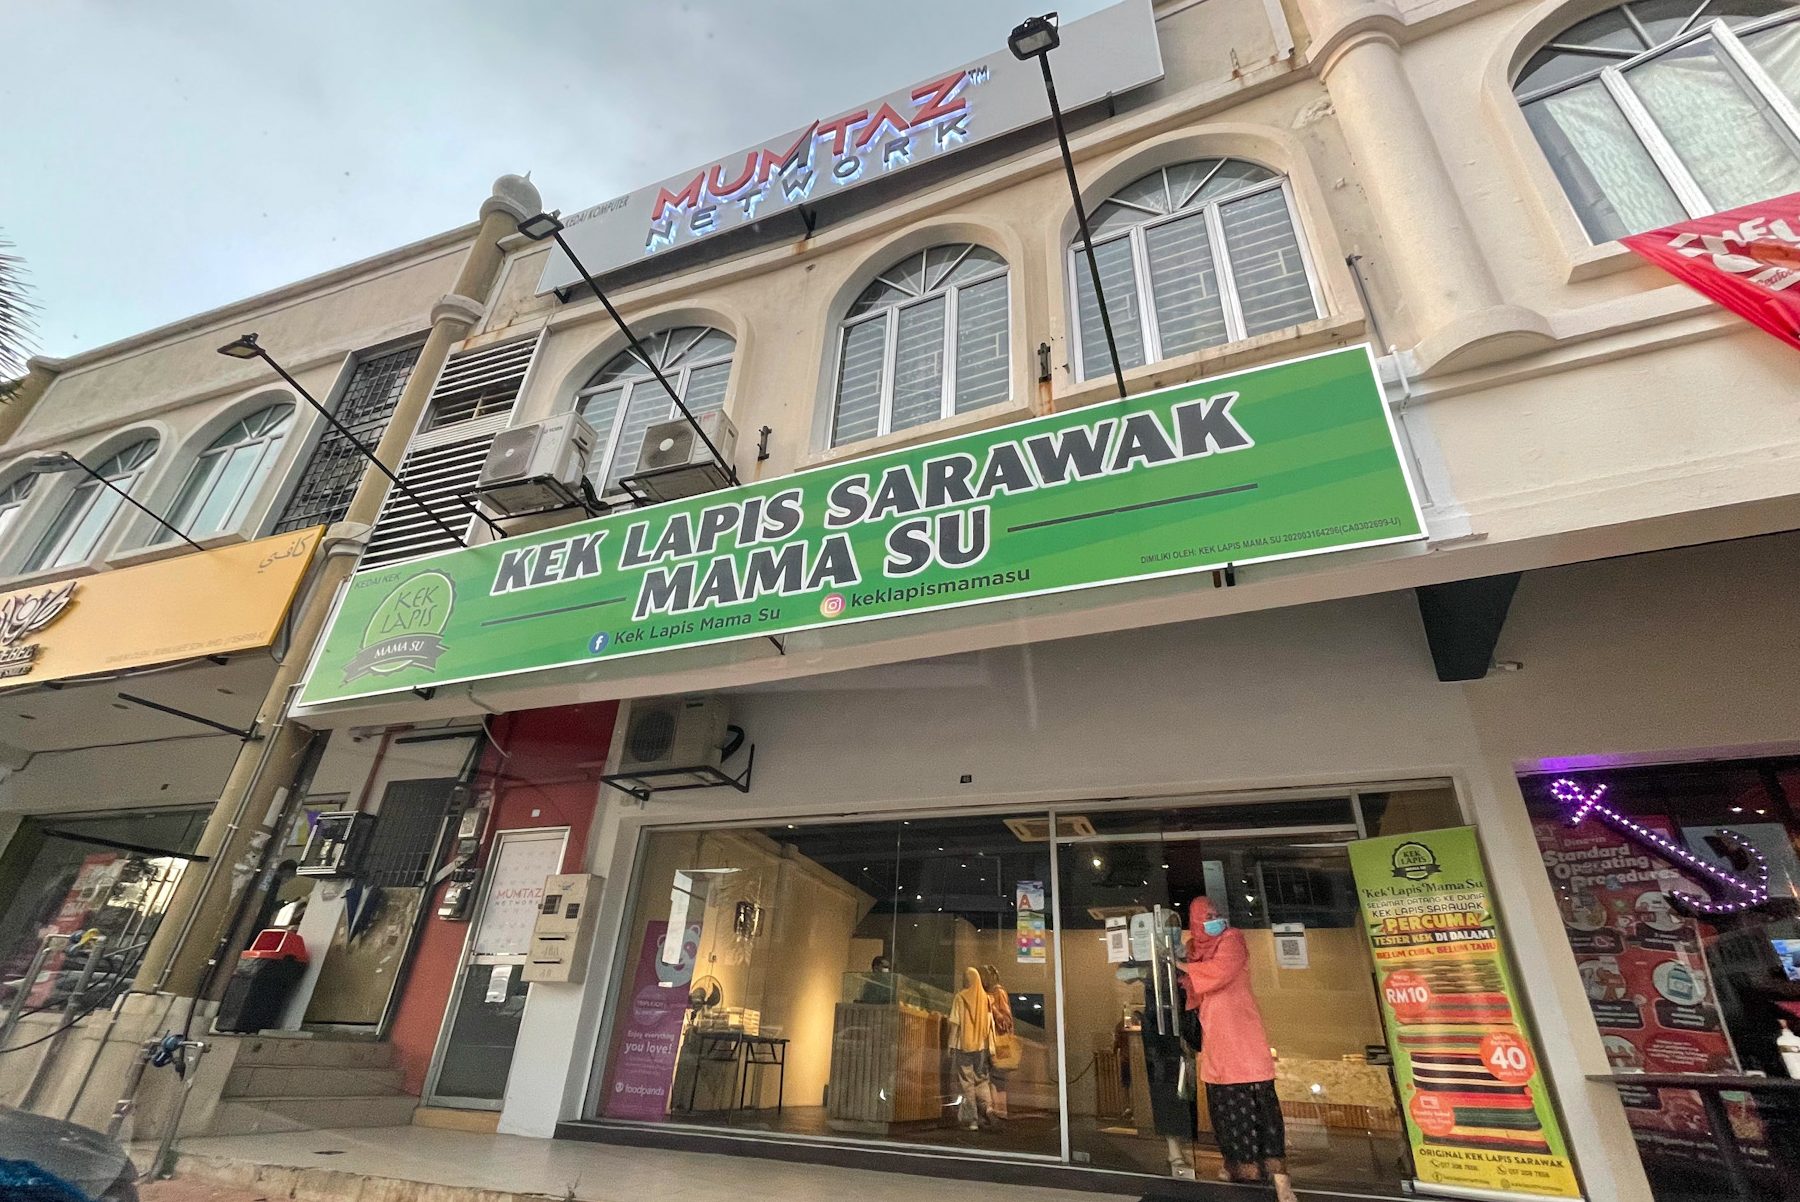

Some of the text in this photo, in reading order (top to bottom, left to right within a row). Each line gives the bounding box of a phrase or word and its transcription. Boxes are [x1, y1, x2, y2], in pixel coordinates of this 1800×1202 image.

[651, 70, 967, 221] MUMTAZ
[645, 113, 968, 250] NETWORK
[588, 195, 630, 220] KOMPUTER
[490, 391, 1255, 595] KEK LAPIS SARAWAK
[1140, 552, 1171, 563] DIMILIKI
[1173, 549, 1196, 559] OLEH:
[1199, 546, 1216, 555] KEK
[1217, 541, 1241, 552] LAPIS
[1242, 538, 1268, 548] MAMA
[1271, 536, 1281, 544] SU
[632, 505, 990, 620] MAMA SU
[394, 585, 440, 610] KEK
[851, 568, 1031, 608] keklapismamasu
[380, 604, 438, 634] LAPIS
[614, 608, 781, 645] Kek Lapis Mama Su
[373, 640, 425, 659] MAMA SU
[1401, 856, 1427, 865] LAPIS
[1403, 850, 1420, 858] KEK
[1542, 843, 1630, 867] Standard
[1554, 856, 1649, 879] Operating
[1362, 878, 1484, 898] Kek Lapis Mama Su
[1570, 868, 1680, 893] Proedures
[496, 888, 543, 899] MUMTAZ
[1366, 899, 1404, 909] SELAMAT
[1406, 896, 1441, 905] DATANG
[1372, 901, 1484, 918] KEK LAPIS SARAWAK
[1384, 912, 1480, 933] PERCUMA
[1375, 935, 1411, 946] TESTER
[1412, 933, 1434, 944] KEK
[1435, 932, 1448, 941] DI
[1449, 929, 1490, 941] DALAM
[1376, 950, 1405, 959] BELUM
[1385, 987, 1428, 1004] RM10
[624, 1041, 673, 1054] you love!
[1490, 1046, 1527, 1070] 40
[625, 1083, 664, 1097] foodpanda
[1419, 1148, 1564, 1168] ORIGINAL KEK LAPIS SARAWAK
